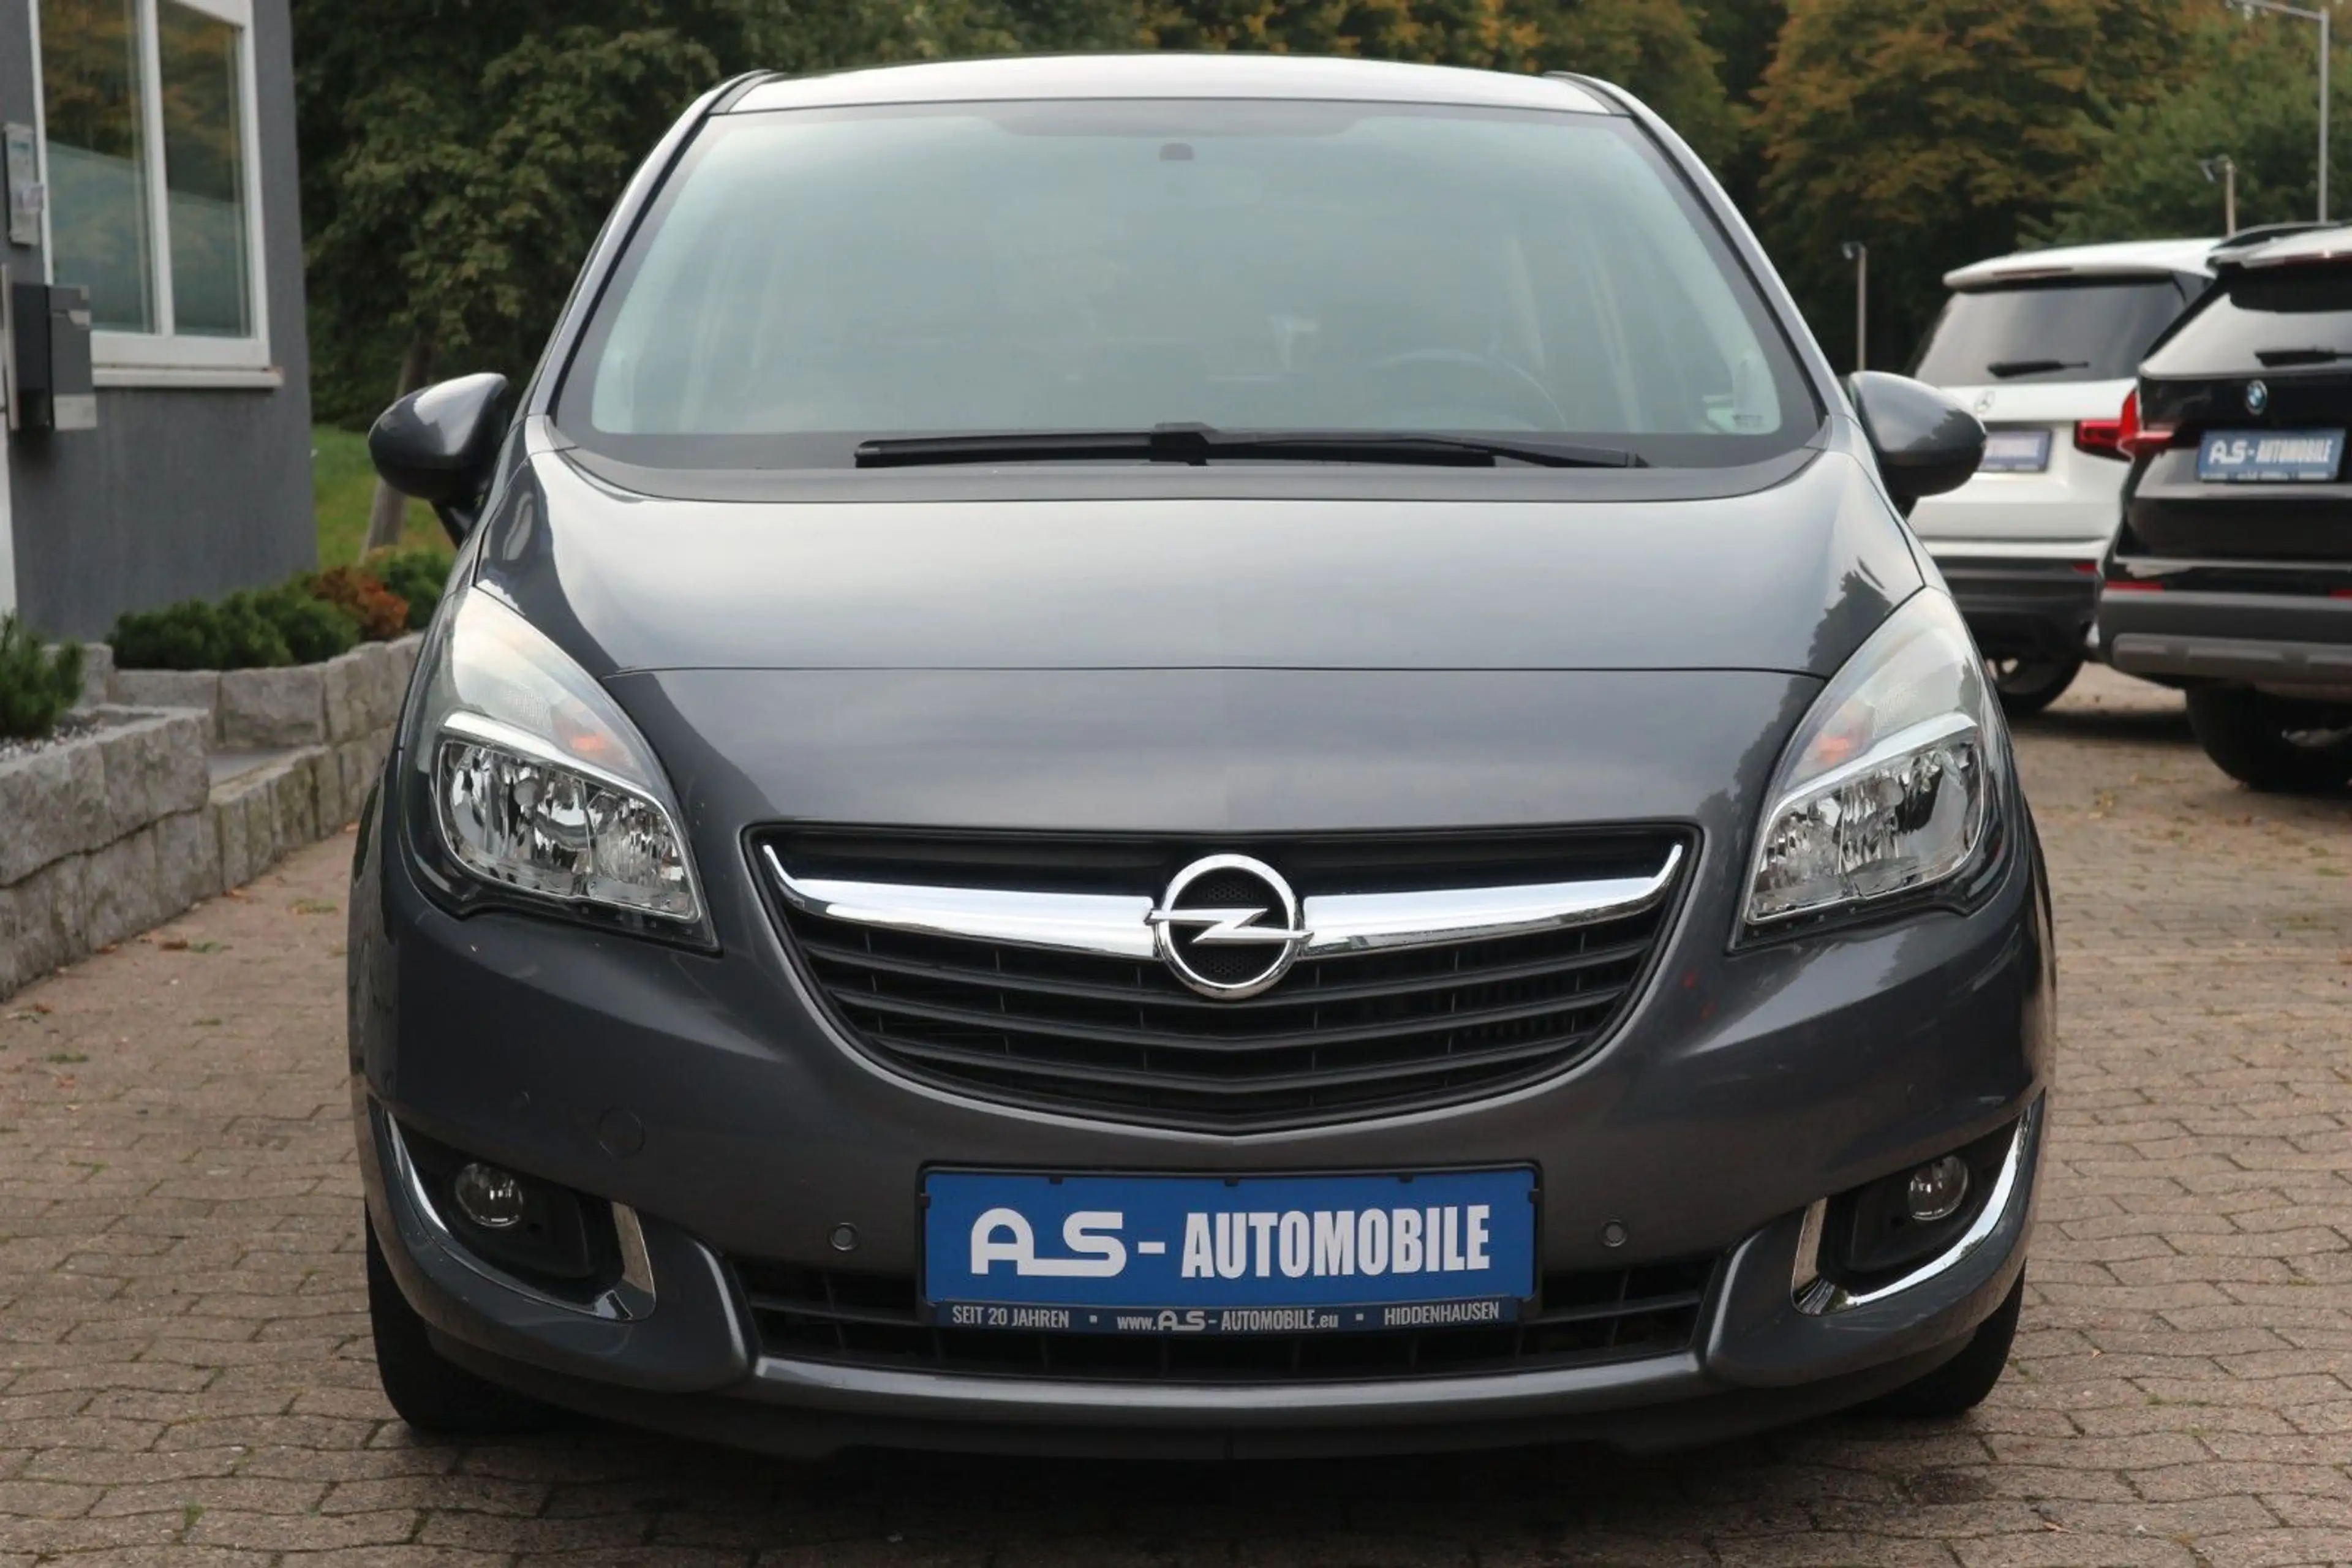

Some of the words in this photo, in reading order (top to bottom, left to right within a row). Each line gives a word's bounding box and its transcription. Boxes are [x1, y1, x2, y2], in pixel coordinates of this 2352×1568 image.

[952, 1305, 984, 1325] SEIT
[987, 1307, 1008, 1326] 20
[1011, 1308, 1070, 1329] JAHREN
[1384, 1301, 1500, 1327] HIDDENHAUSEN
